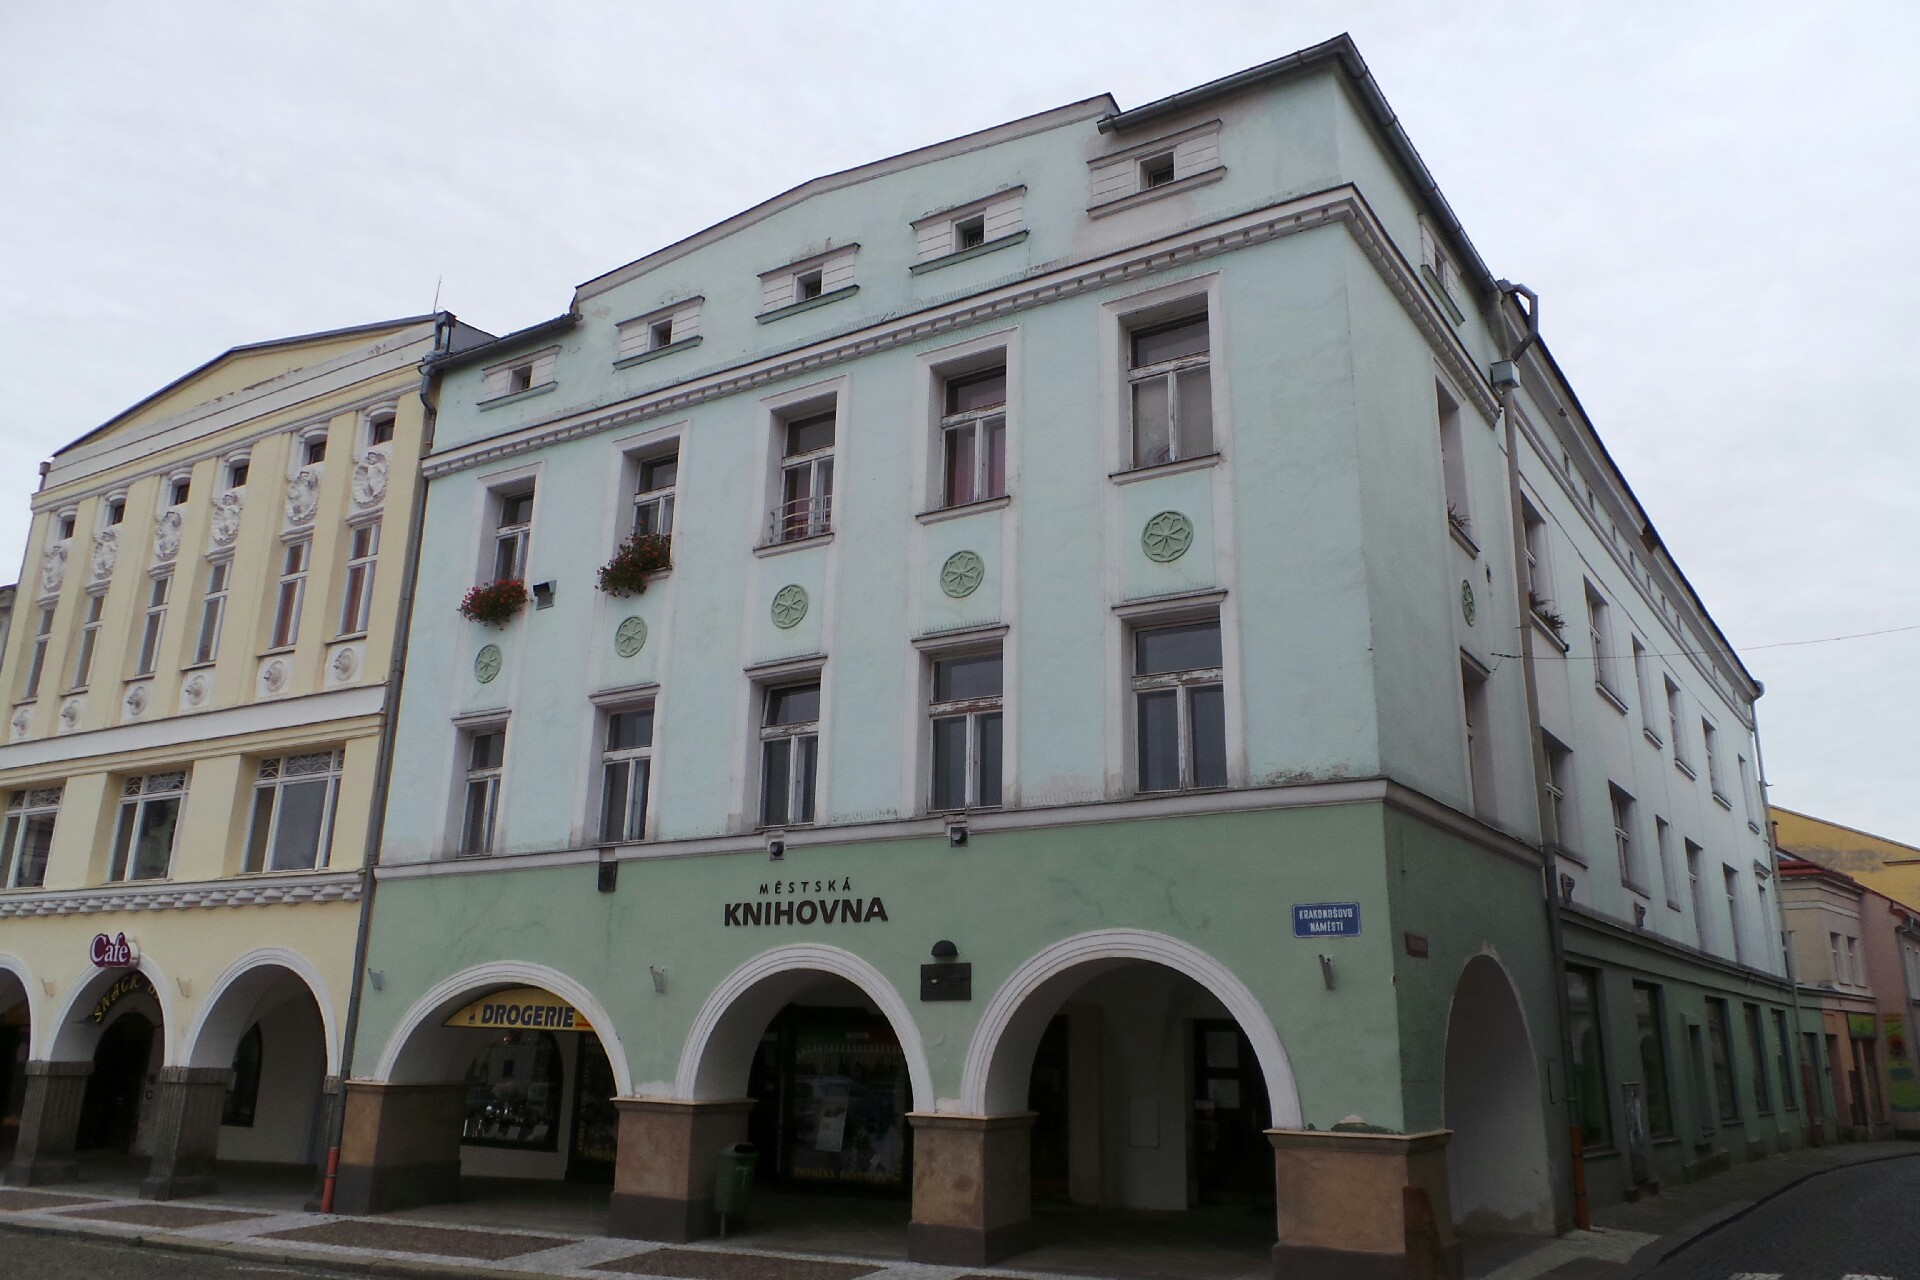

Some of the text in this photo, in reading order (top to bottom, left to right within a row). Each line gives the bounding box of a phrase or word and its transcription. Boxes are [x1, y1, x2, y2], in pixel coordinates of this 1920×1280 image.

[759, 877, 851, 895] MĚSTSKÁ
[724, 897, 889, 926] KNIHOVNA
[1299, 907, 1353, 920] KRAKONOŠOVO
[93, 975, 140, 1023] SNACK
[481, 1004, 575, 1028] DROGERIE
